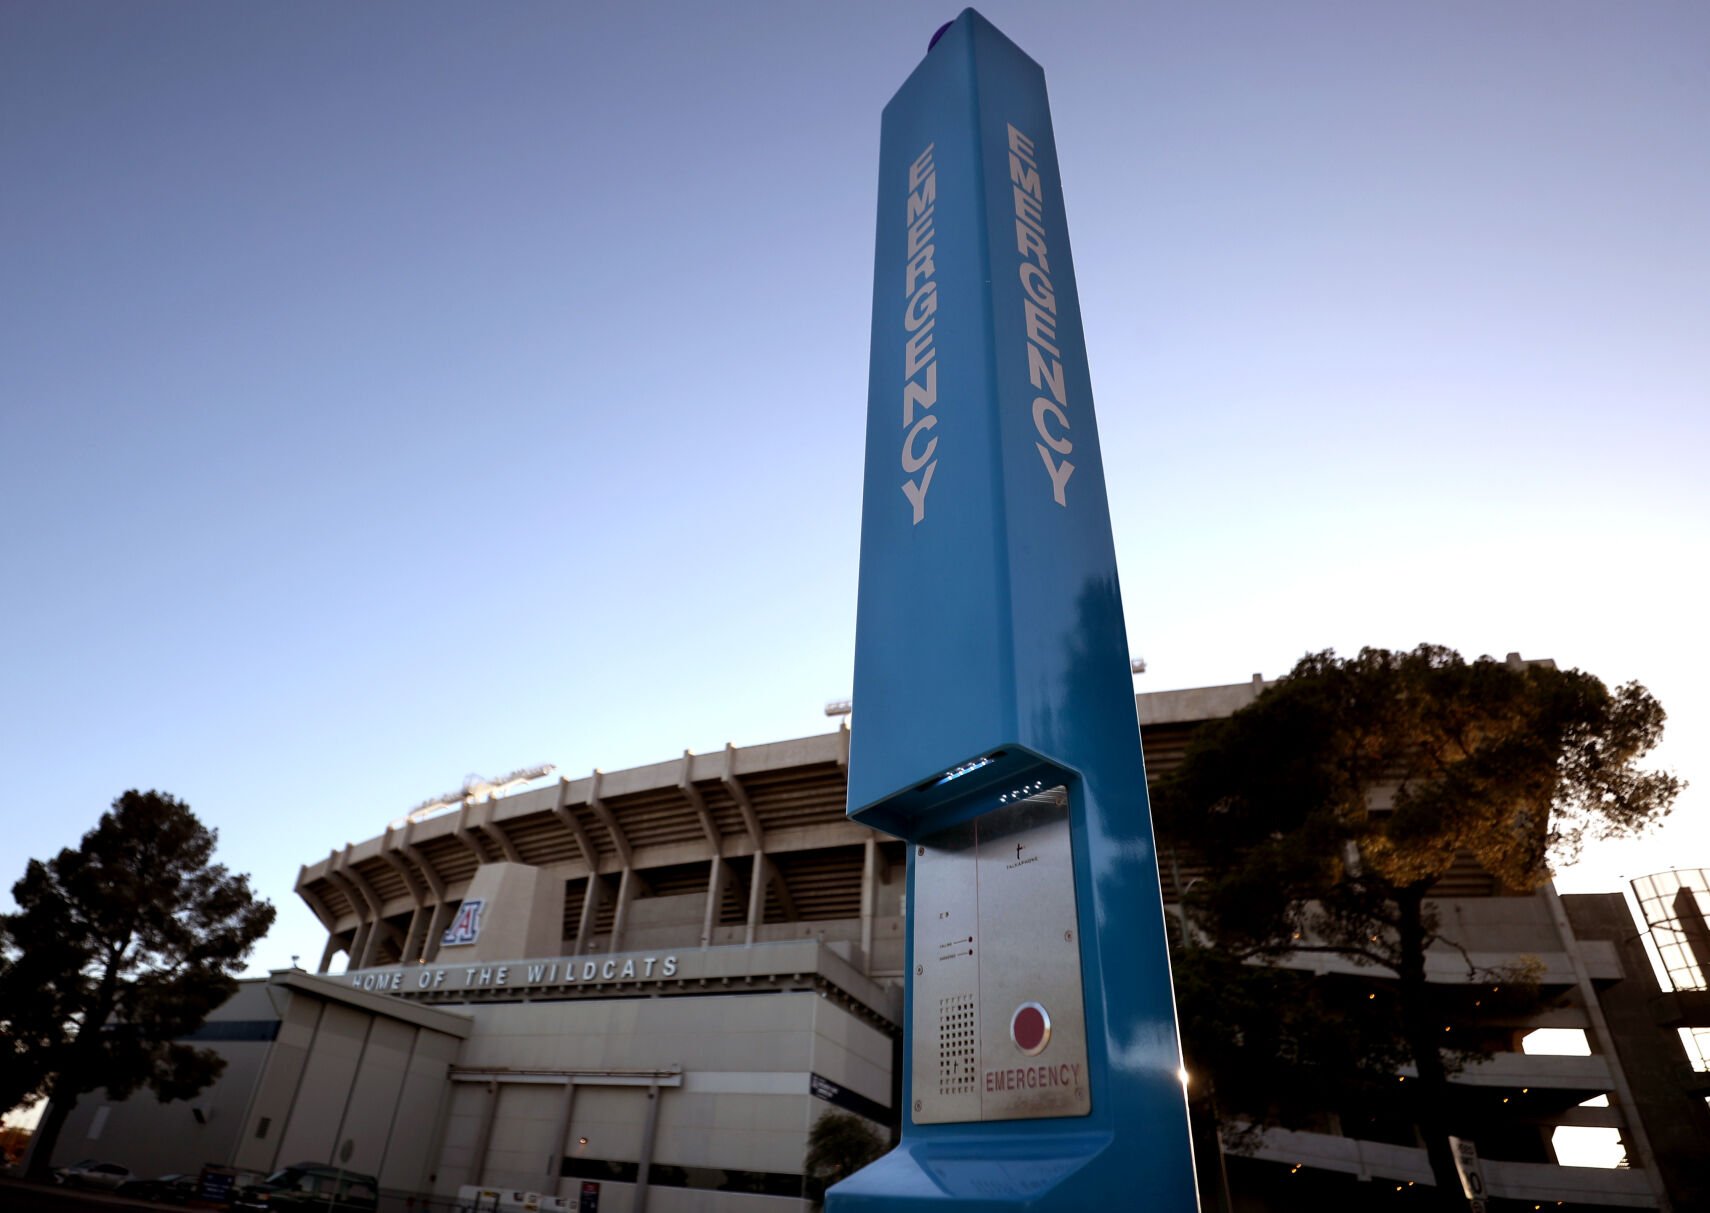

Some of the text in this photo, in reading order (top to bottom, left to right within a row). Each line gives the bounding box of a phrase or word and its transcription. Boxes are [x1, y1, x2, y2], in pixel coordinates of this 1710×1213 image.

[900, 141, 939, 527] EMERGENCY
[1006, 121, 1076, 508] EMERGENCY
[352, 956, 677, 991] HOME OF THE WILDCATS
[986, 1063, 1080, 1092] EMERGENCY
